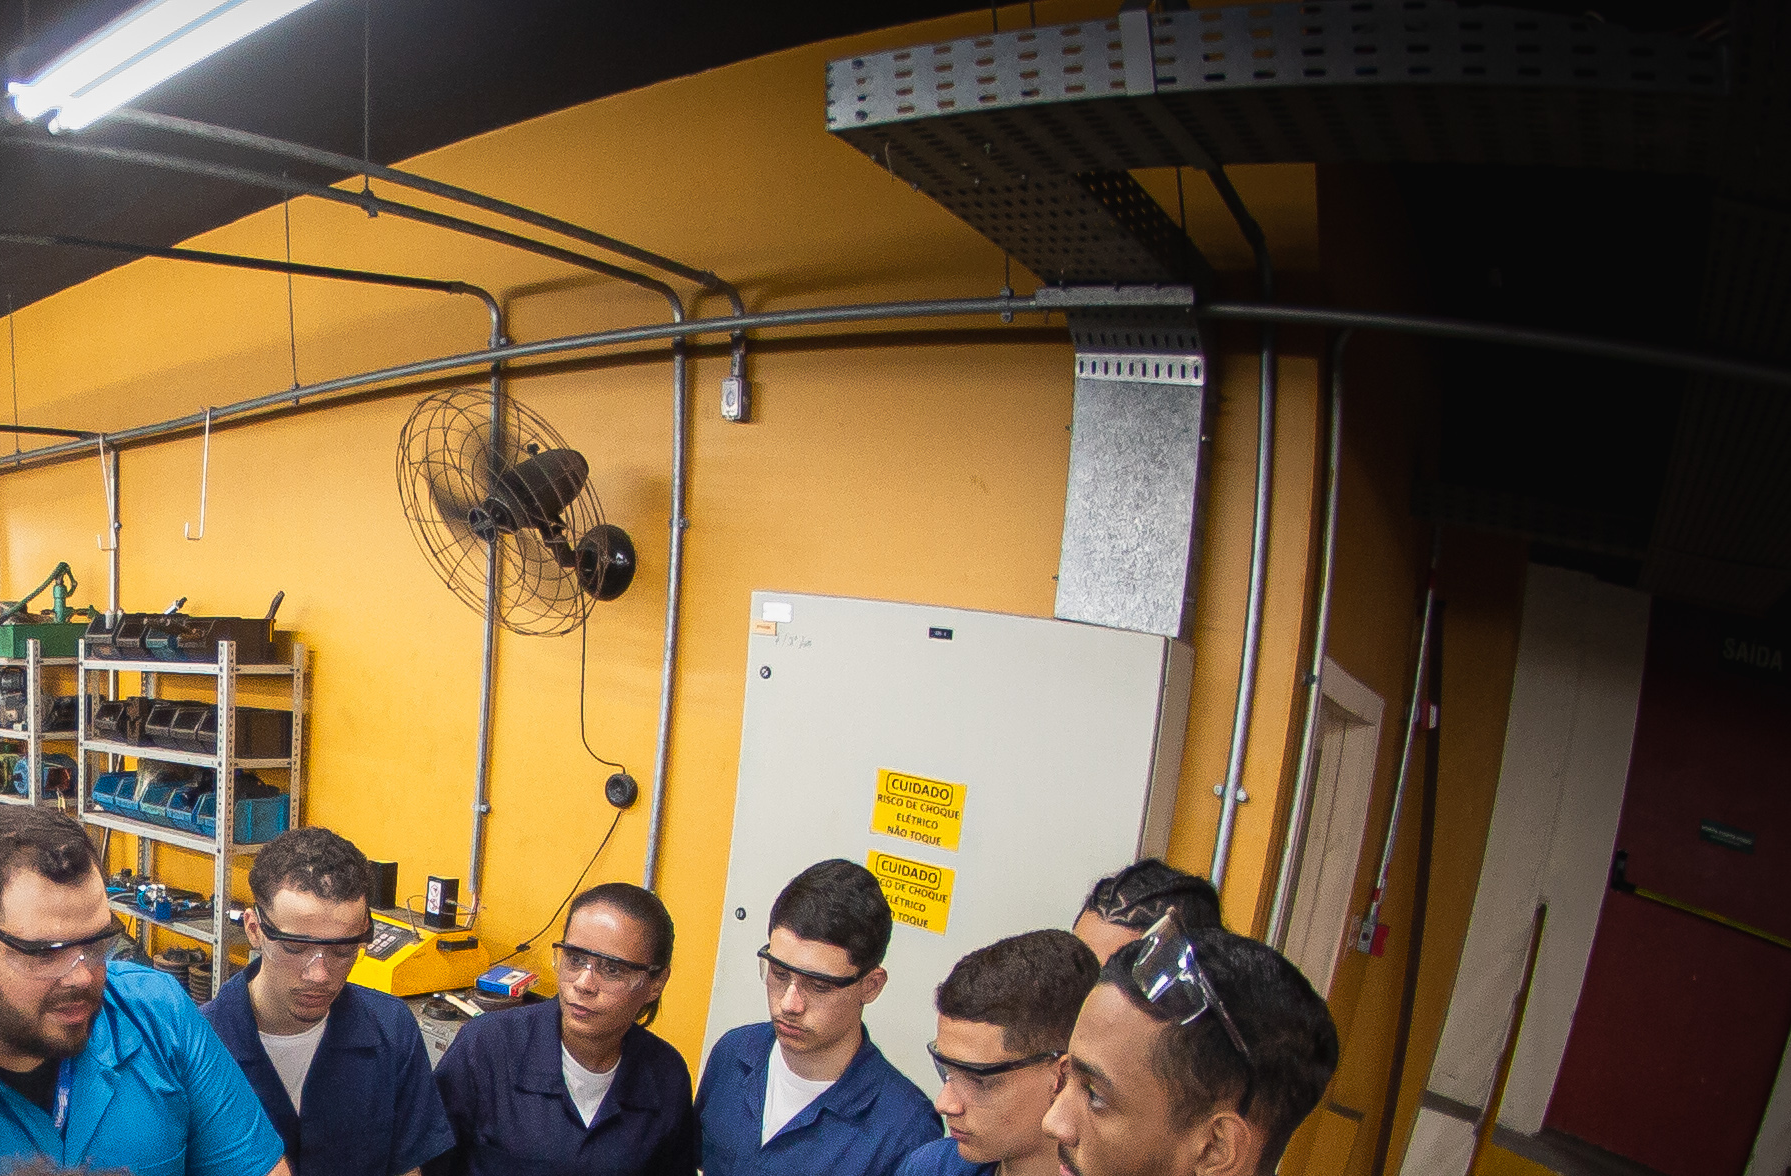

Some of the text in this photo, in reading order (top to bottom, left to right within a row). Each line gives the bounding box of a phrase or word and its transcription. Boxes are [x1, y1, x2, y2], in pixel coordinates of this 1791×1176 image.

[891, 778, 949, 800] CUIDADO
[877, 793, 960, 820] RISCO DE CHOQUE
[896, 812, 938, 830] ELÉTRICO
[886, 824, 942, 846] NÃO TOQUE
[881, 860, 937, 883] CUIDADO
[894, 881, 906, 892] DE
[909, 886, 948, 903] CHOQUE
[898, 912, 928, 928] TOQUE
